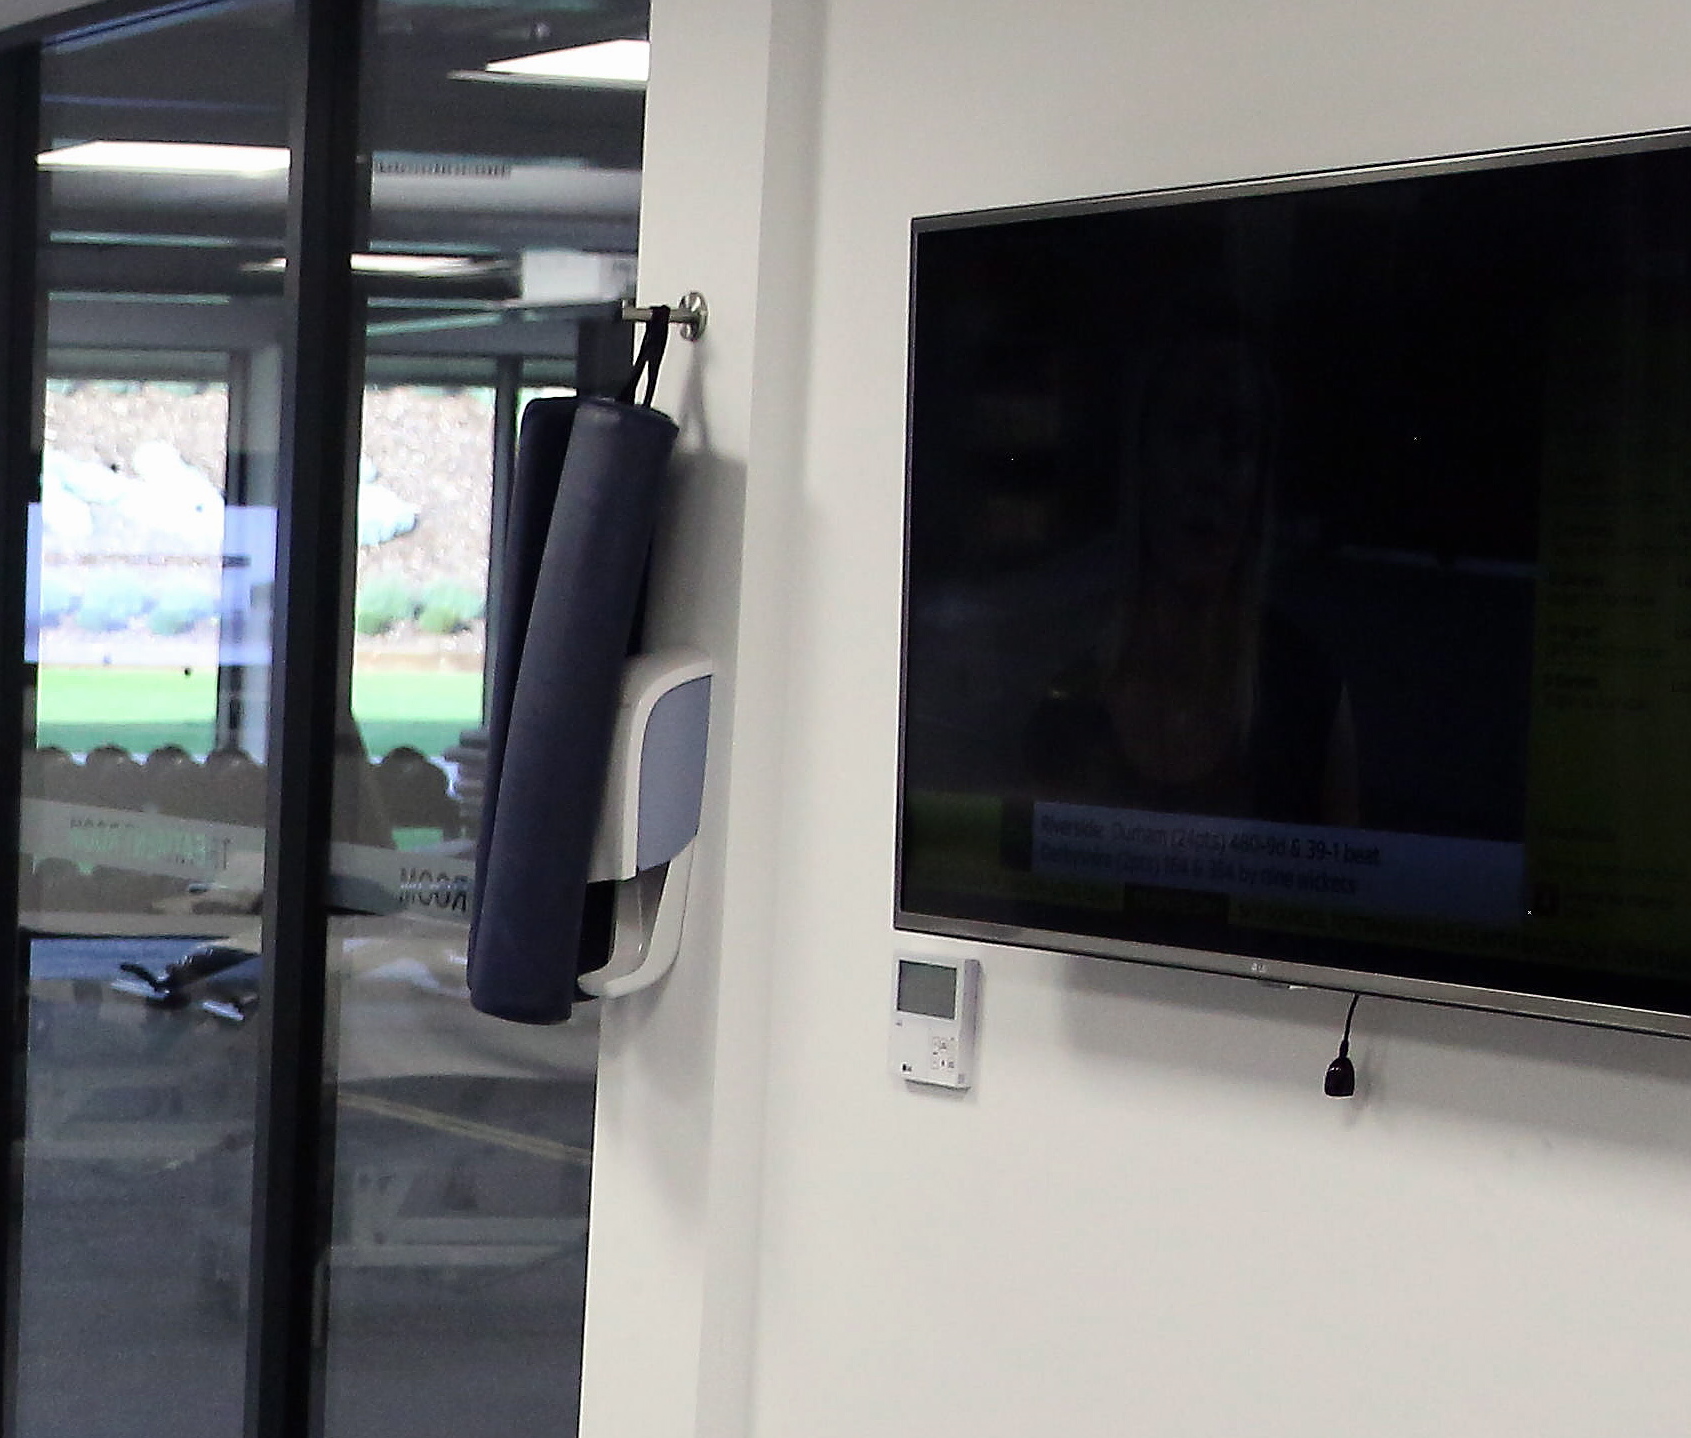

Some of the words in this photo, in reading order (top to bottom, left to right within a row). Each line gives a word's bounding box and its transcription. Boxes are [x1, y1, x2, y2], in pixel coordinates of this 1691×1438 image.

[1306, 839, 1340, 861] 39-1
[1343, 842, 1380, 866] beat
[1238, 864, 1256, 886] by
